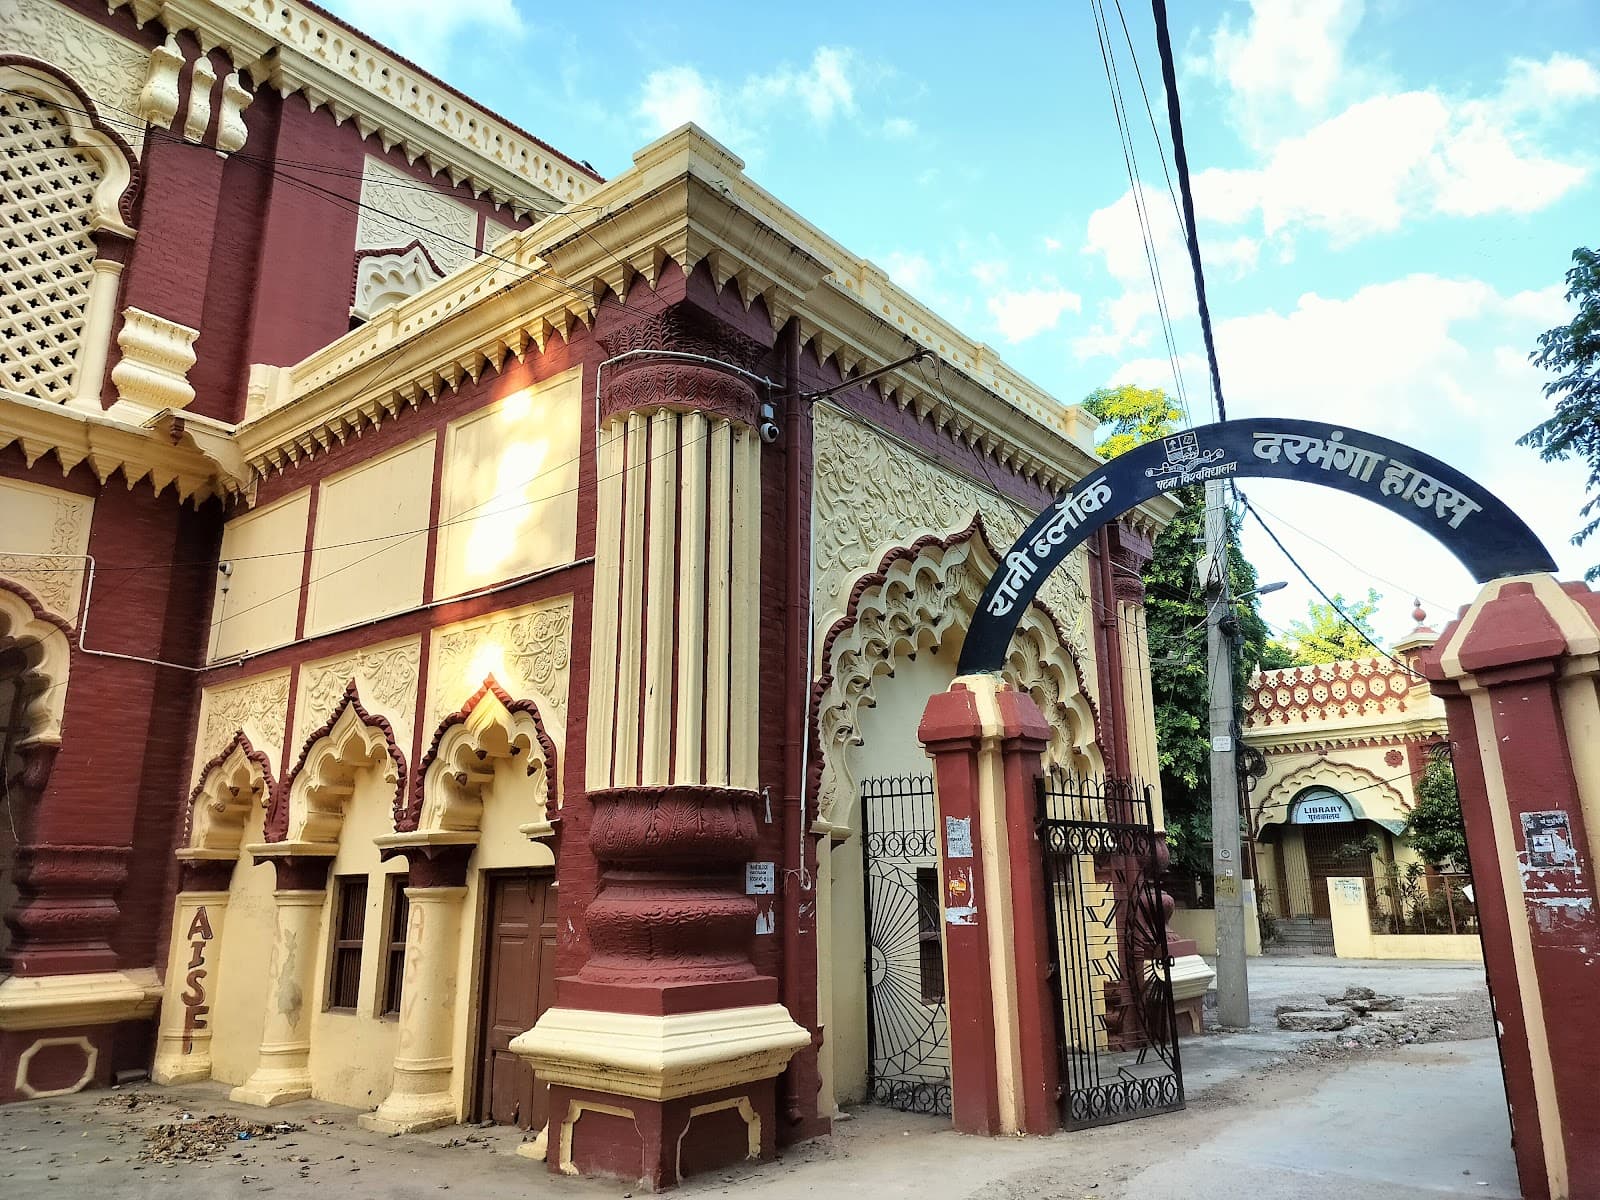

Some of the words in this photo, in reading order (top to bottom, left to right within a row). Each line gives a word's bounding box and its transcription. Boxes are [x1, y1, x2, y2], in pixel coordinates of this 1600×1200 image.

[1156, 477, 1178, 490] पटना
[1180, 461, 1237, 485] विश्वविद्यालय
[1252, 430, 1386, 483] दरभंगा
[1379, 458, 1484, 530] हाउस
[986, 547, 1039, 617] रानी
[1029, 475, 1112, 558] ब्लॉक
[1304, 806, 1342, 814] LIBRARY
